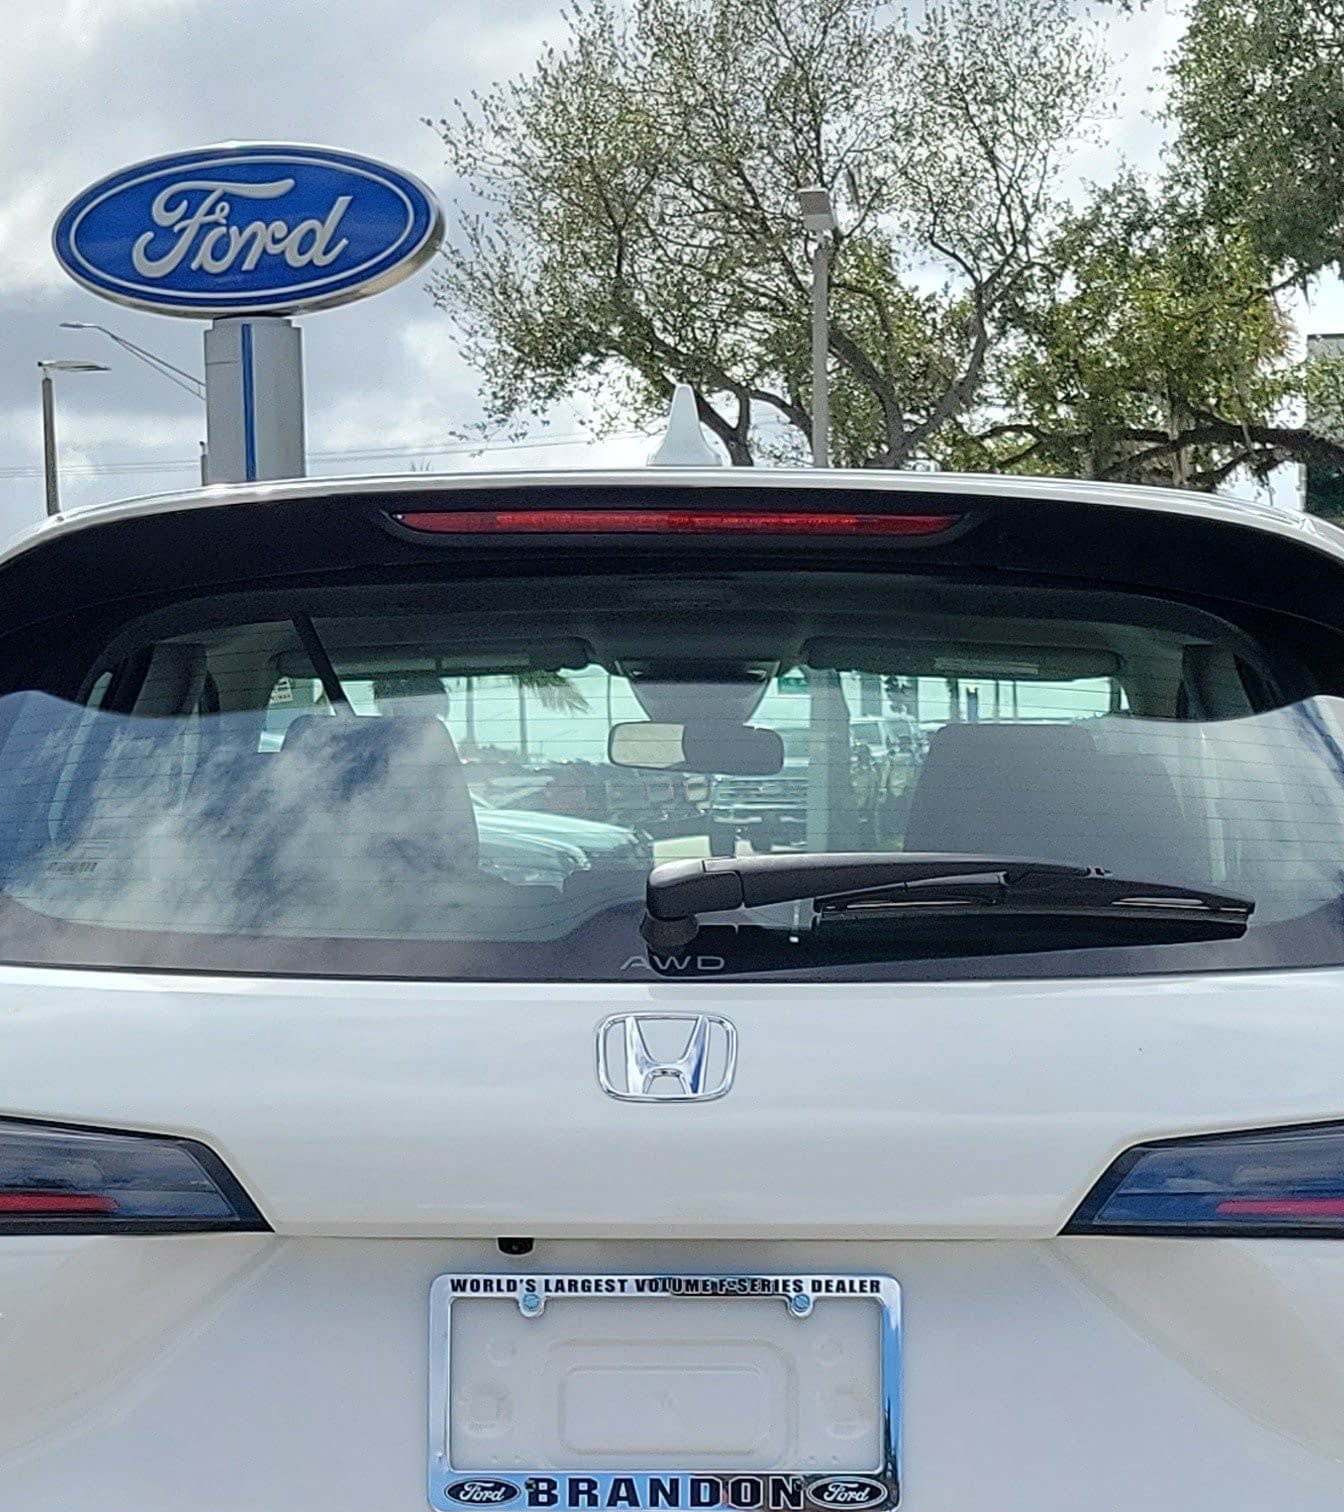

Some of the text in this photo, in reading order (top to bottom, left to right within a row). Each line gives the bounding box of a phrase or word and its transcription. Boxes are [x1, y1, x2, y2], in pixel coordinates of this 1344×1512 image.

[131, 178, 353, 279] Ford
[619, 955, 725, 970] AWD
[449, 1278, 881, 1294] WORLD'S LARGEST VOLUME F-SERIES DEALER
[459, 1476, 871, 1509] Ford BRANDON Ford
